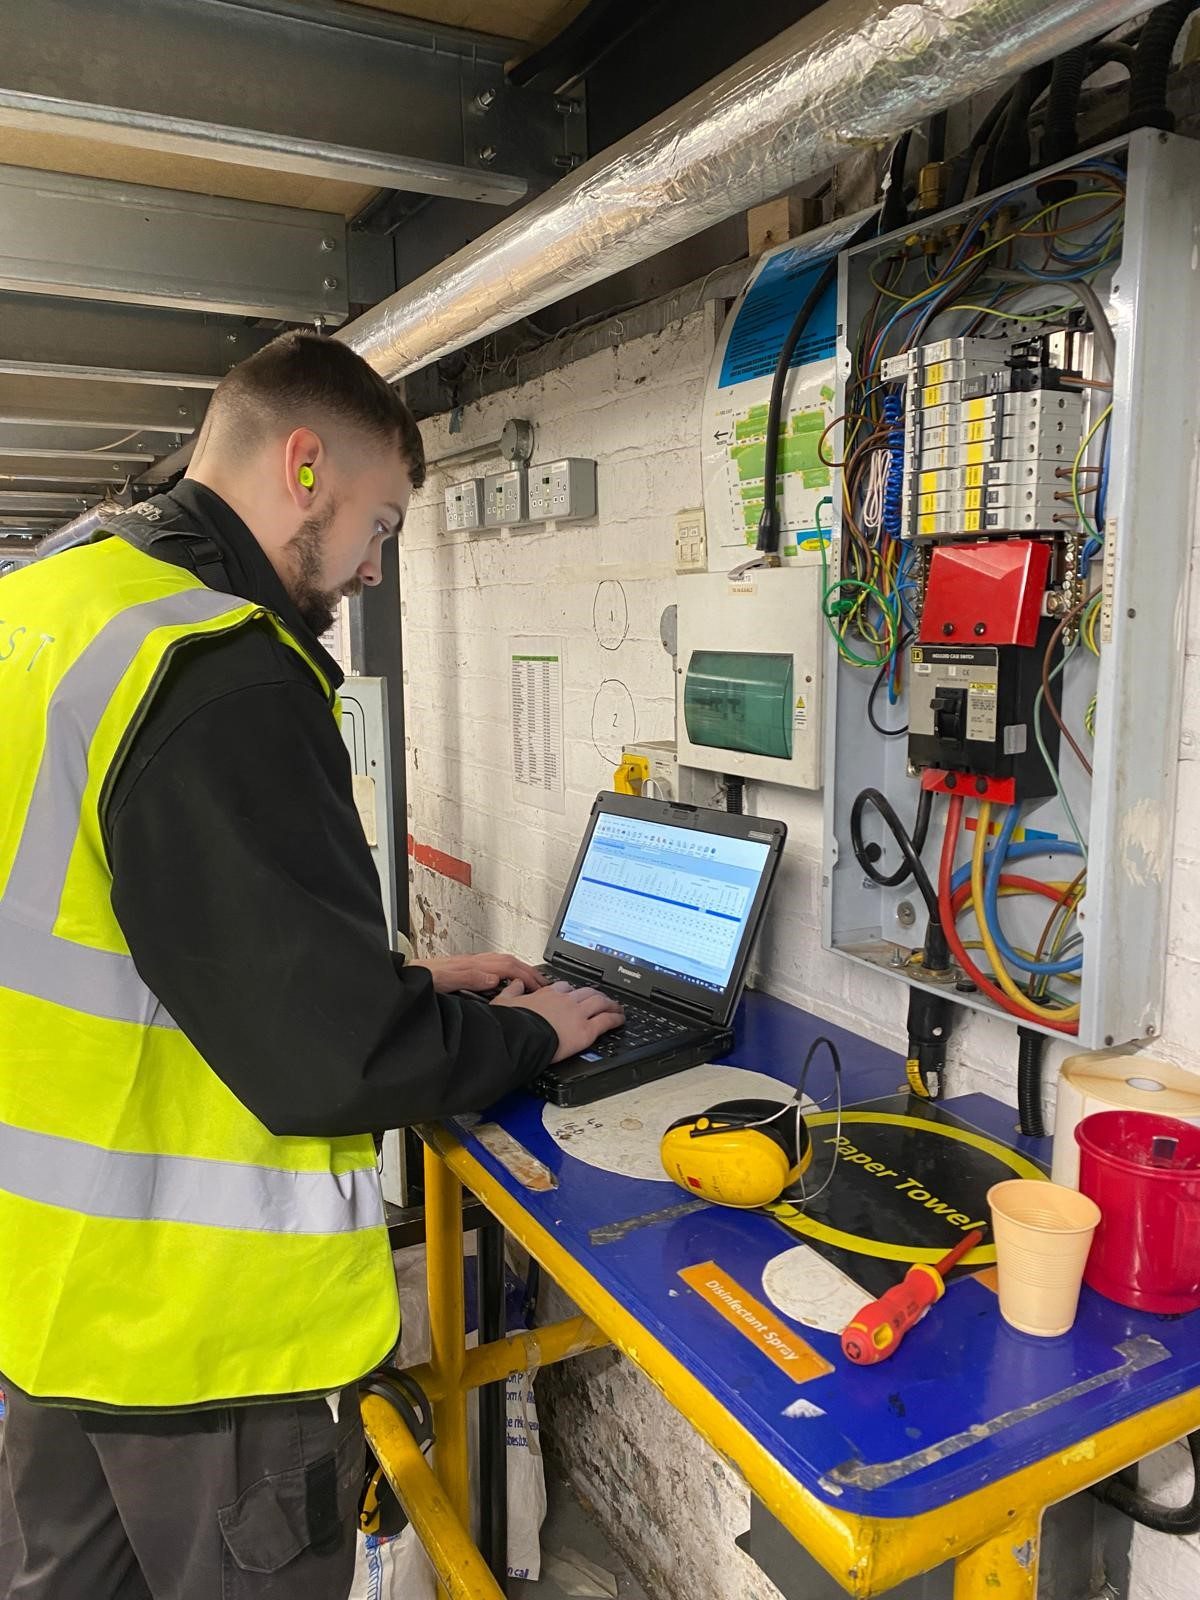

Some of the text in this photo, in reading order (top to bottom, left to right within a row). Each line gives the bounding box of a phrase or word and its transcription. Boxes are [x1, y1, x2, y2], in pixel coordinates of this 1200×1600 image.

[0, 618, 55, 672] ST
[823, 1136, 988, 1231] Paper Towel
[705, 1279, 800, 1361] Disinfectant Spray
